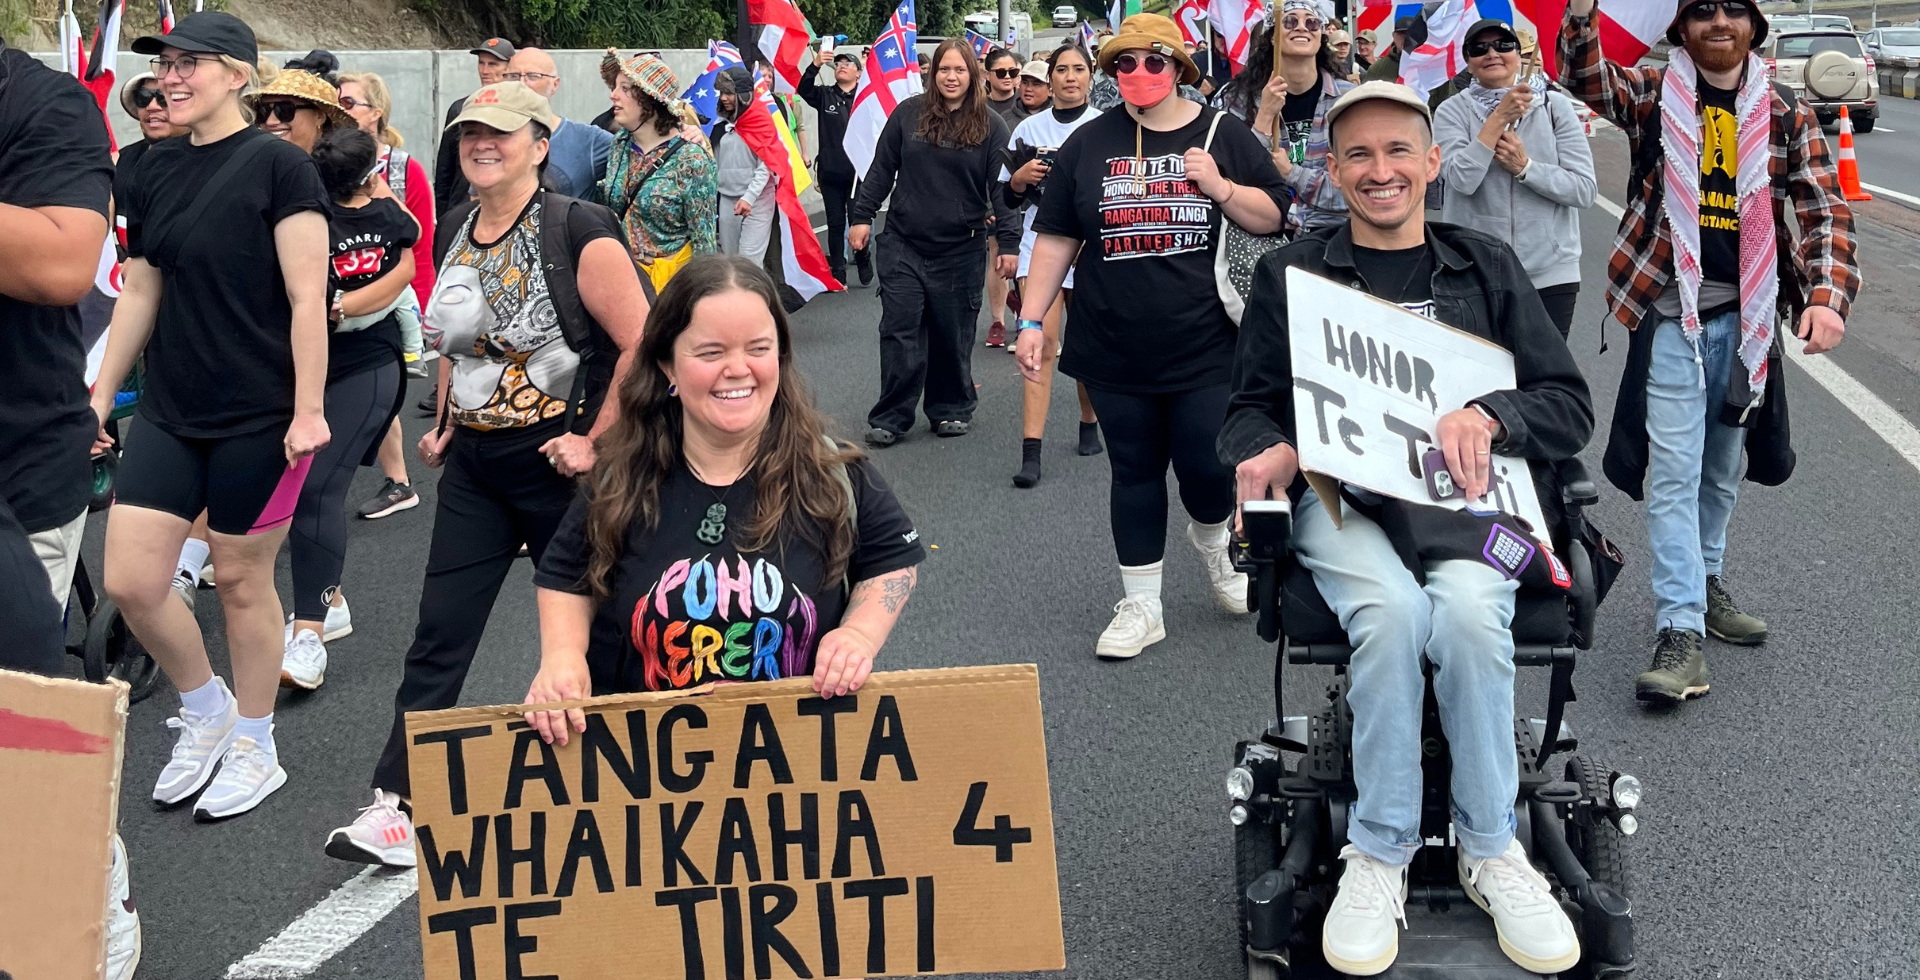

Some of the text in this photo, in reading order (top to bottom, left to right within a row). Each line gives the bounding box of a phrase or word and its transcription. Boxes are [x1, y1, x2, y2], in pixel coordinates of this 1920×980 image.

[1149, 181, 1169, 194] THE
[1150, 160, 1167, 175] TE
[1104, 207, 1208, 225] RANGATIRATANGA
[343, 249, 378, 272] 35
[1104, 233, 1208, 254] PARTNERSHIP
[1323, 317, 1438, 416] HONOR
[1293, 376, 1364, 456] Te
[655, 553, 784, 622] POHO
[416, 781, 1032, 901] WHAIKAHA 4
[428, 876, 935, 980] TE TIRITI
